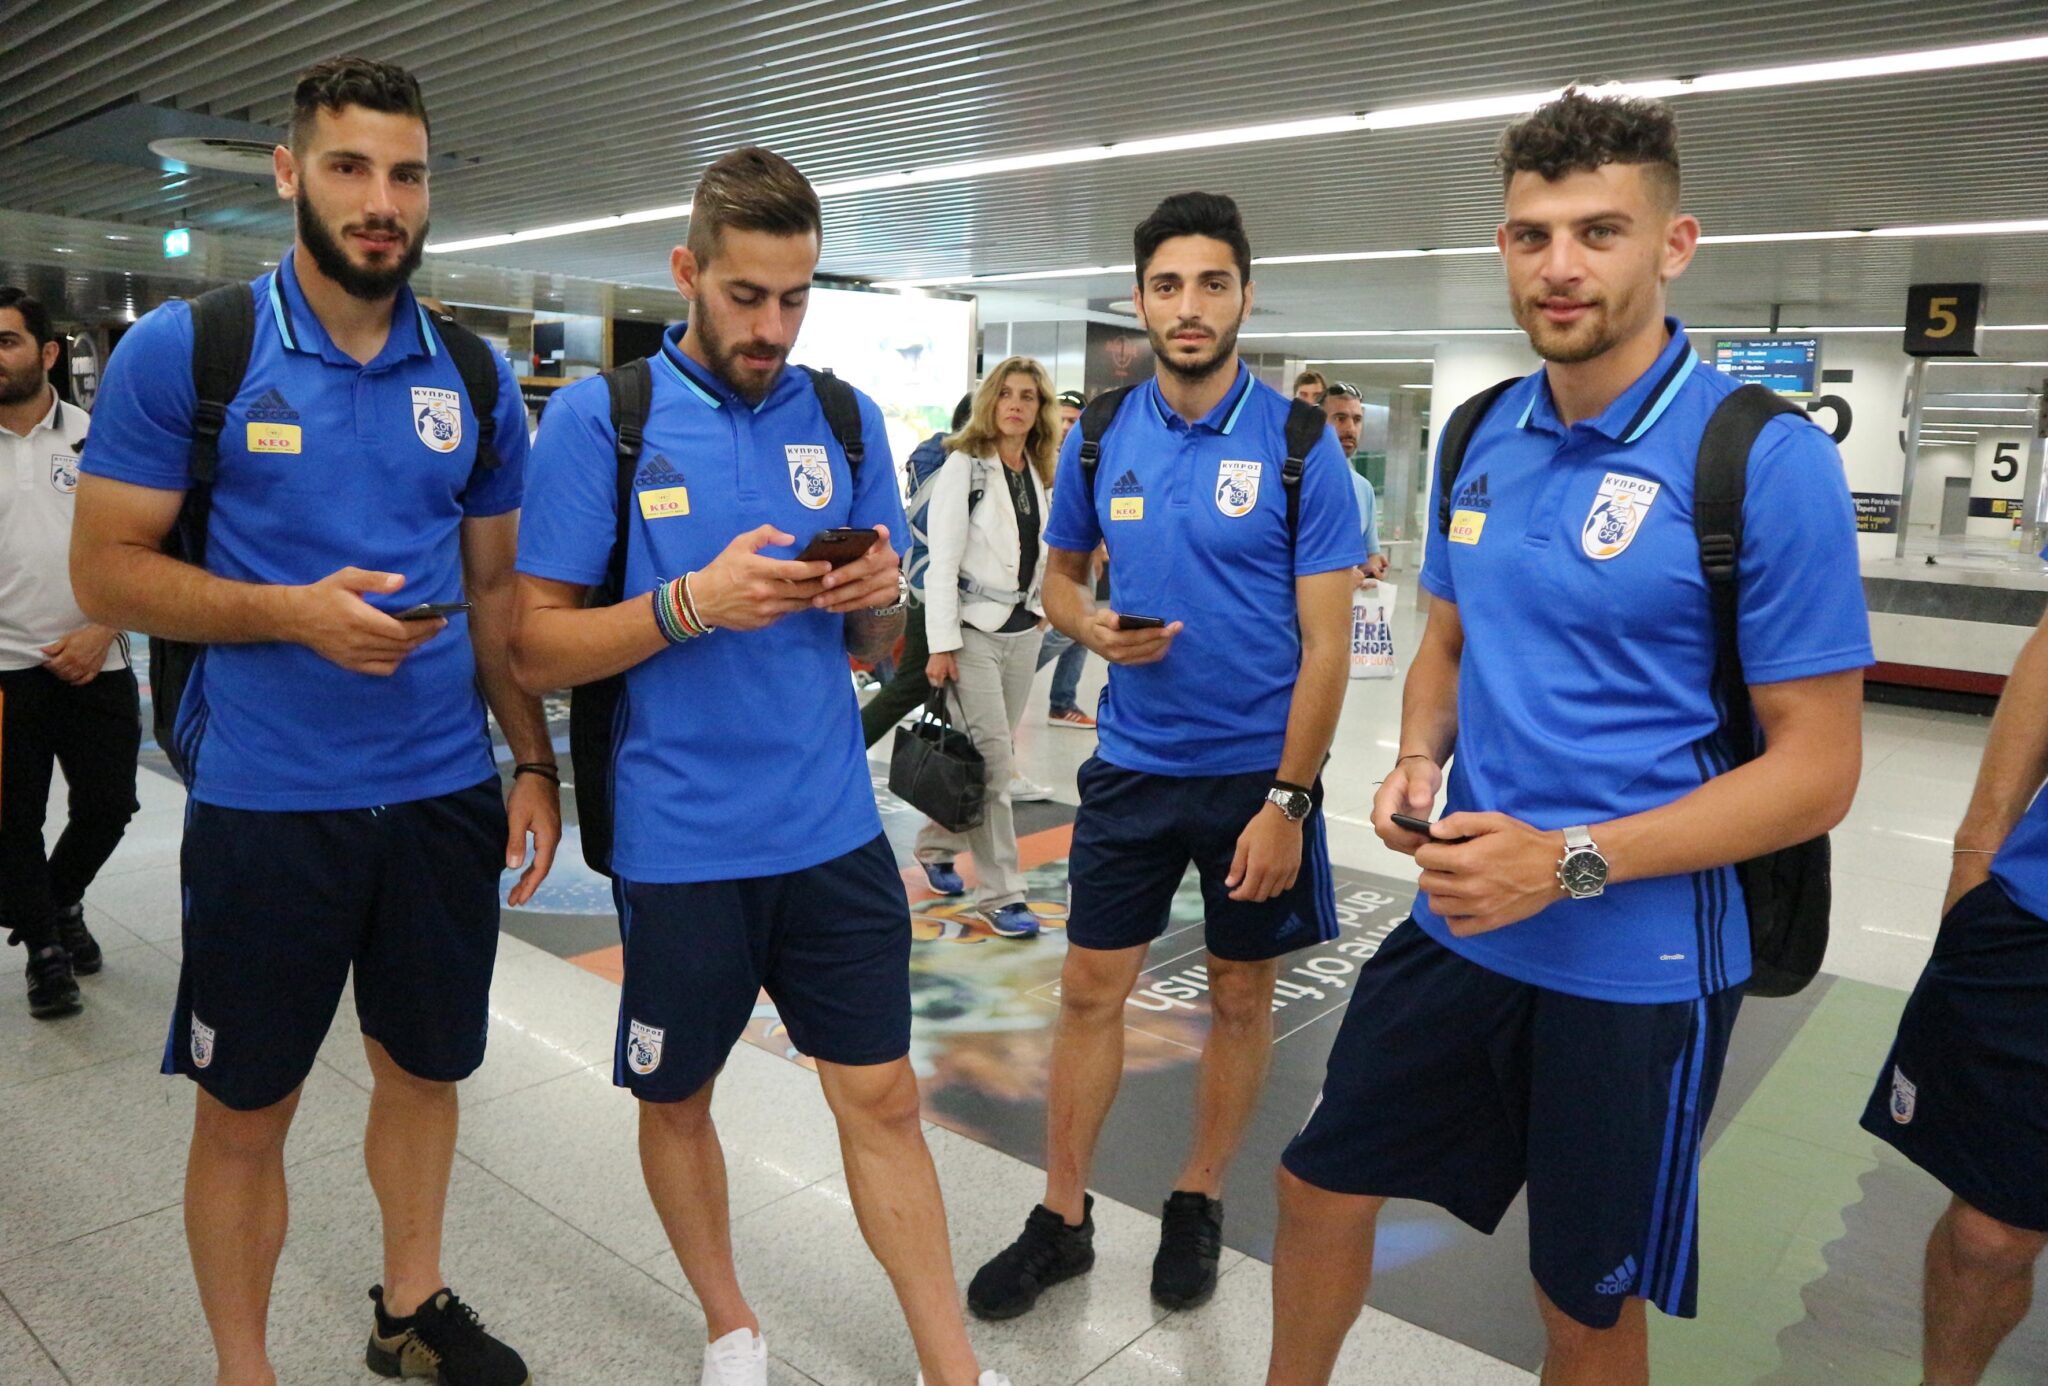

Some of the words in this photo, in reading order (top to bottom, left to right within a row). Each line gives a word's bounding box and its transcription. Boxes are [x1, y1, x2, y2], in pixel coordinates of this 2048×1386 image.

[1924, 297, 1958, 338] 5
[413, 389, 457, 401] ΚΥΠΡΟΣ
[258, 438, 290, 447] KEO
[1991, 442, 2020, 483] 5
[1605, 476, 1656, 495] ΚΥΠΡΟΣ
[650, 502, 678, 512] KEO
[1453, 525, 1473, 536] KEO
[1354, 622, 1392, 641] FRE
[1353, 641, 1393, 655] SHOPS
[1292, 956, 1355, 989] of
